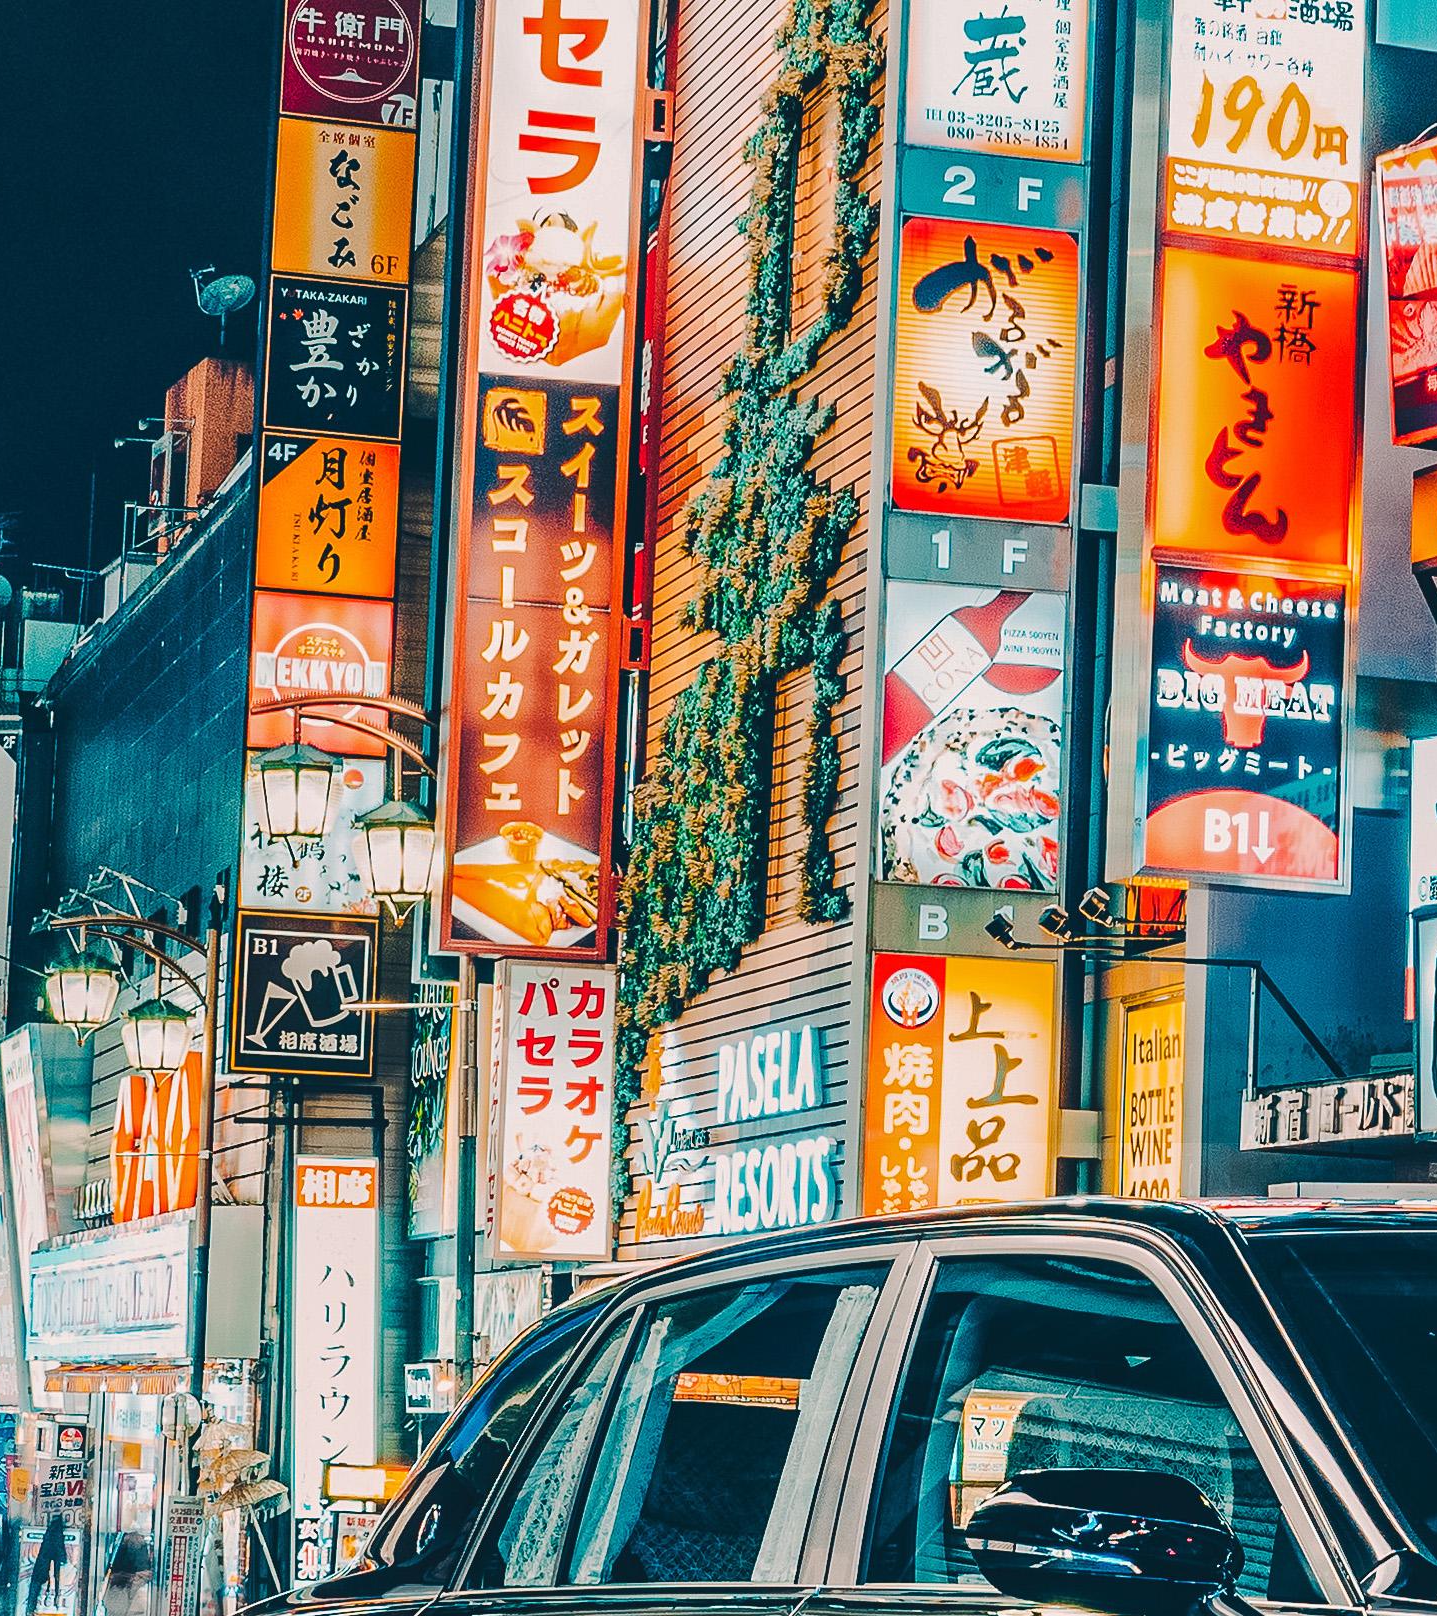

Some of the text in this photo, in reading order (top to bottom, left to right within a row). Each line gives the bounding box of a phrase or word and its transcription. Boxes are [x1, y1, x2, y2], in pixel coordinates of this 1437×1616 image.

[383, 100, 414, 125] 7F
[1191, 69, 1349, 166] 190円
[327, 149, 363, 270] なごみ
[371, 254, 401, 276] 6F
[1274, 283, 1322, 366] 新橋
[268, 443, 298, 462] 4F
[308, 447, 354, 585] 月灯り
[552, 396, 605, 816] スイーツ&ガレット
[1159, 580, 1338, 620] Meat & Cheese
[480, 463, 535, 813] スコールカフェ
[1198, 615, 1297, 648] Factory
[1156, 668, 1336, 722] BIG MEAT
[1203, 807, 1250, 855] B1
[252, 937, 279, 957] B1
[278, 1030, 359, 1055] 相席酒場
[516, 977, 561, 1116] パセラ
[1131, 1026, 1182, 1067] Italian
[563, 979, 607, 1165] カラオケ
[716, 1024, 816, 1125] PASELA
[1130, 1092, 1176, 1128] BOTTLE
[1129, 1129, 1173, 1166] WINE
[714, 1135, 831, 1235] RESORTS
